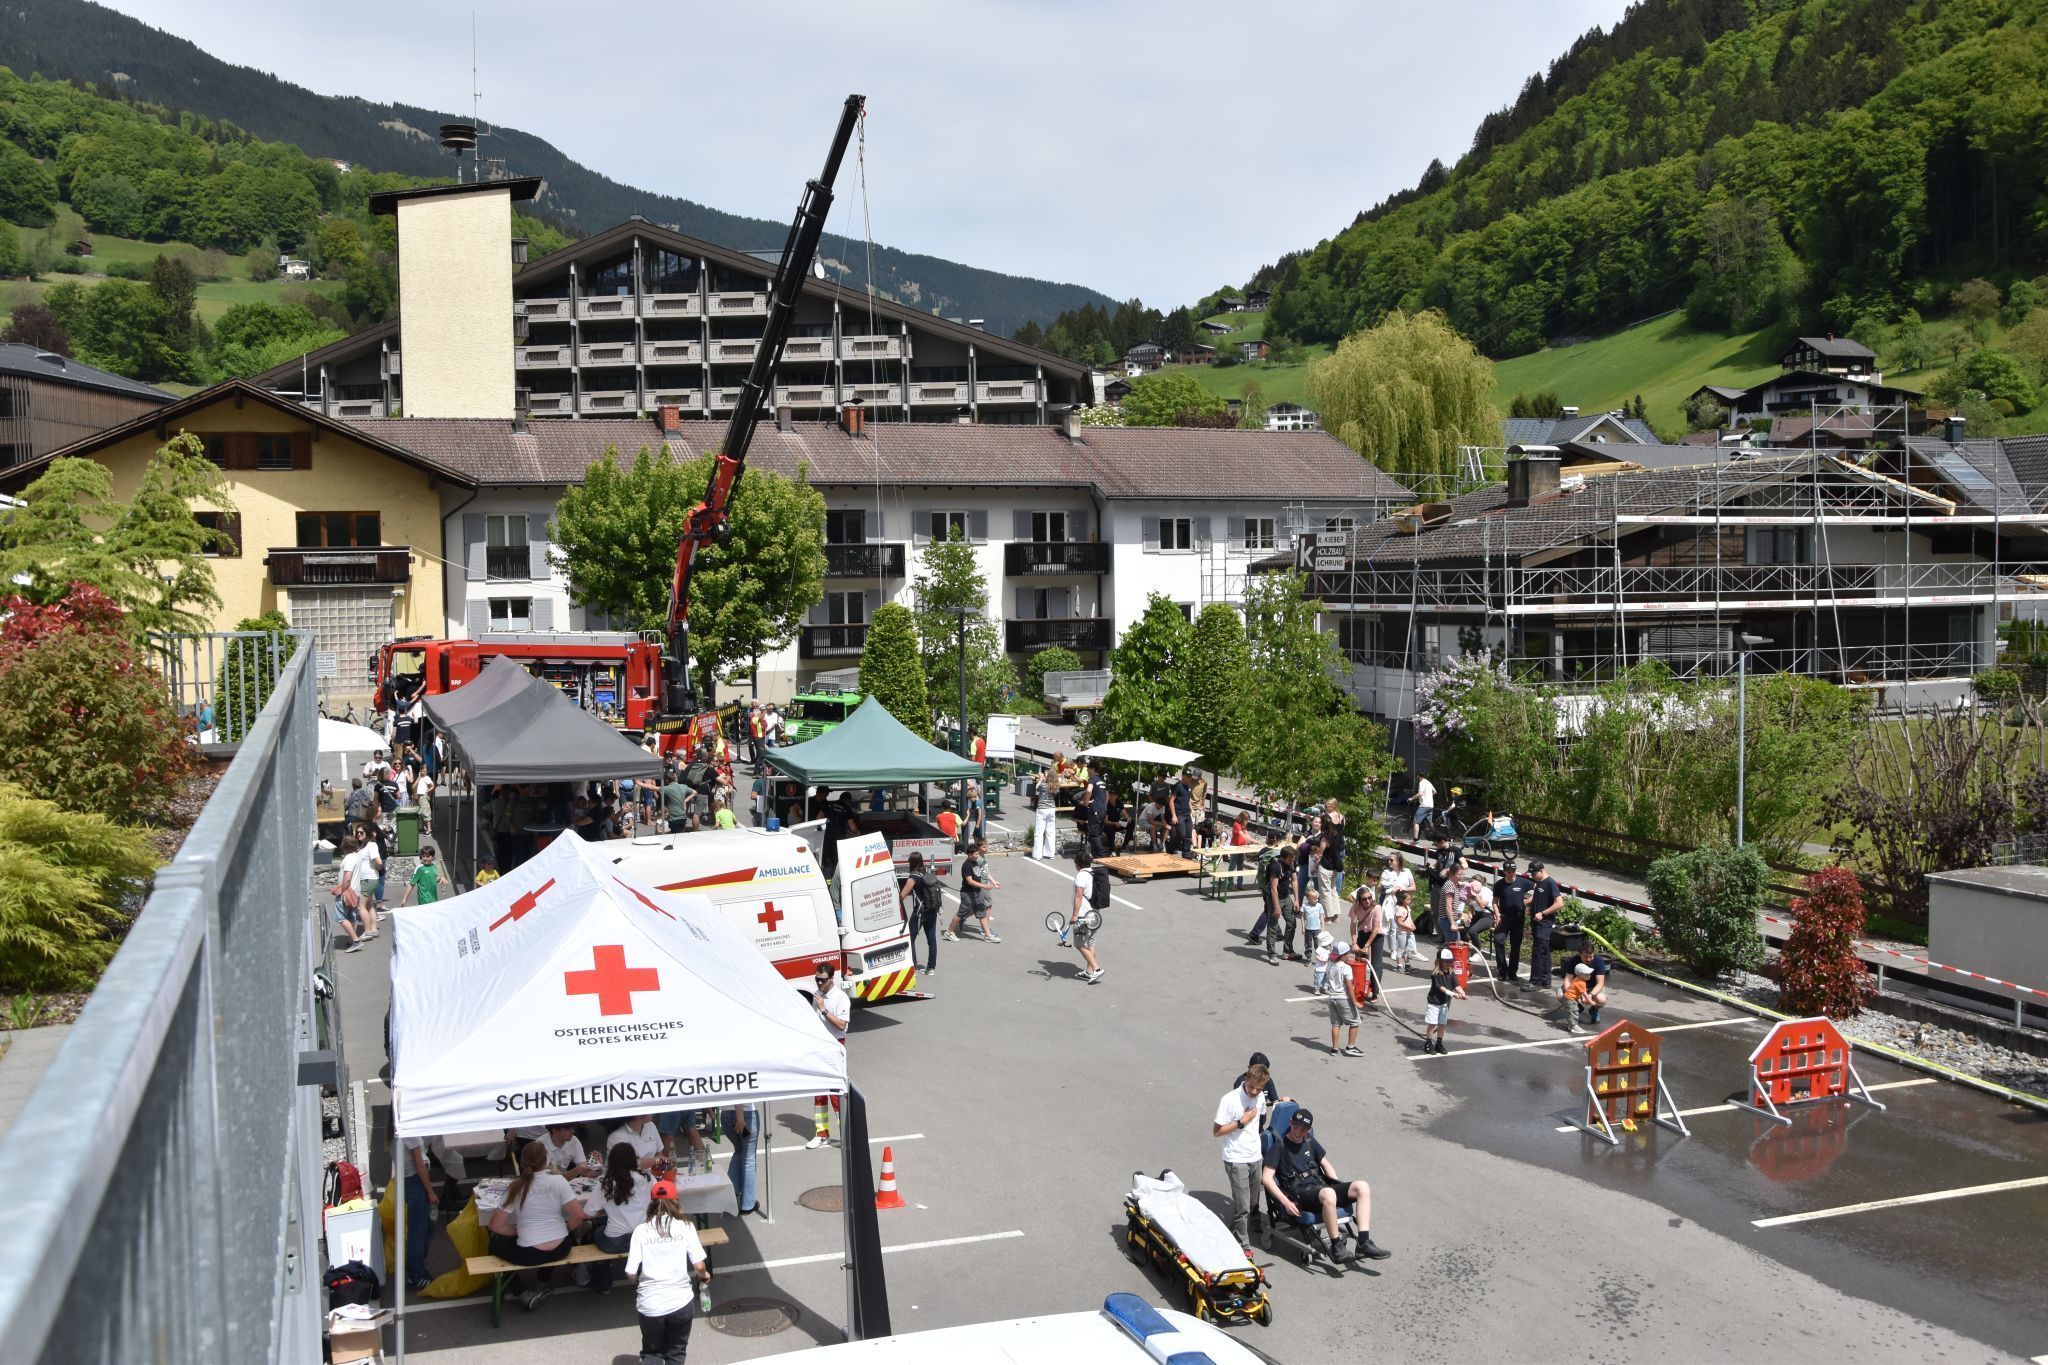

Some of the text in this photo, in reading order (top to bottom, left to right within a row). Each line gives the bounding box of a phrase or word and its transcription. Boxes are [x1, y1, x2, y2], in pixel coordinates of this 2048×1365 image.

[1324, 536, 1344, 544] KIEBER
[1316, 547, 1344, 556] HOLZBAU
[1316, 559, 1344, 567] SCHRUNS
[892, 839, 934, 848] EUERWEHR
[758, 864, 811, 878] AMBULANCE
[811, 954, 840, 964] VORARLBERG
[554, 1020, 684, 1038] ÖSTERREICHISCHES
[578, 1031, 668, 1046] ROTES KREUZ
[495, 1072, 759, 1112] SCHNELLEINSATZGRUPPE
[645, 1233, 684, 1245] JUGEND
